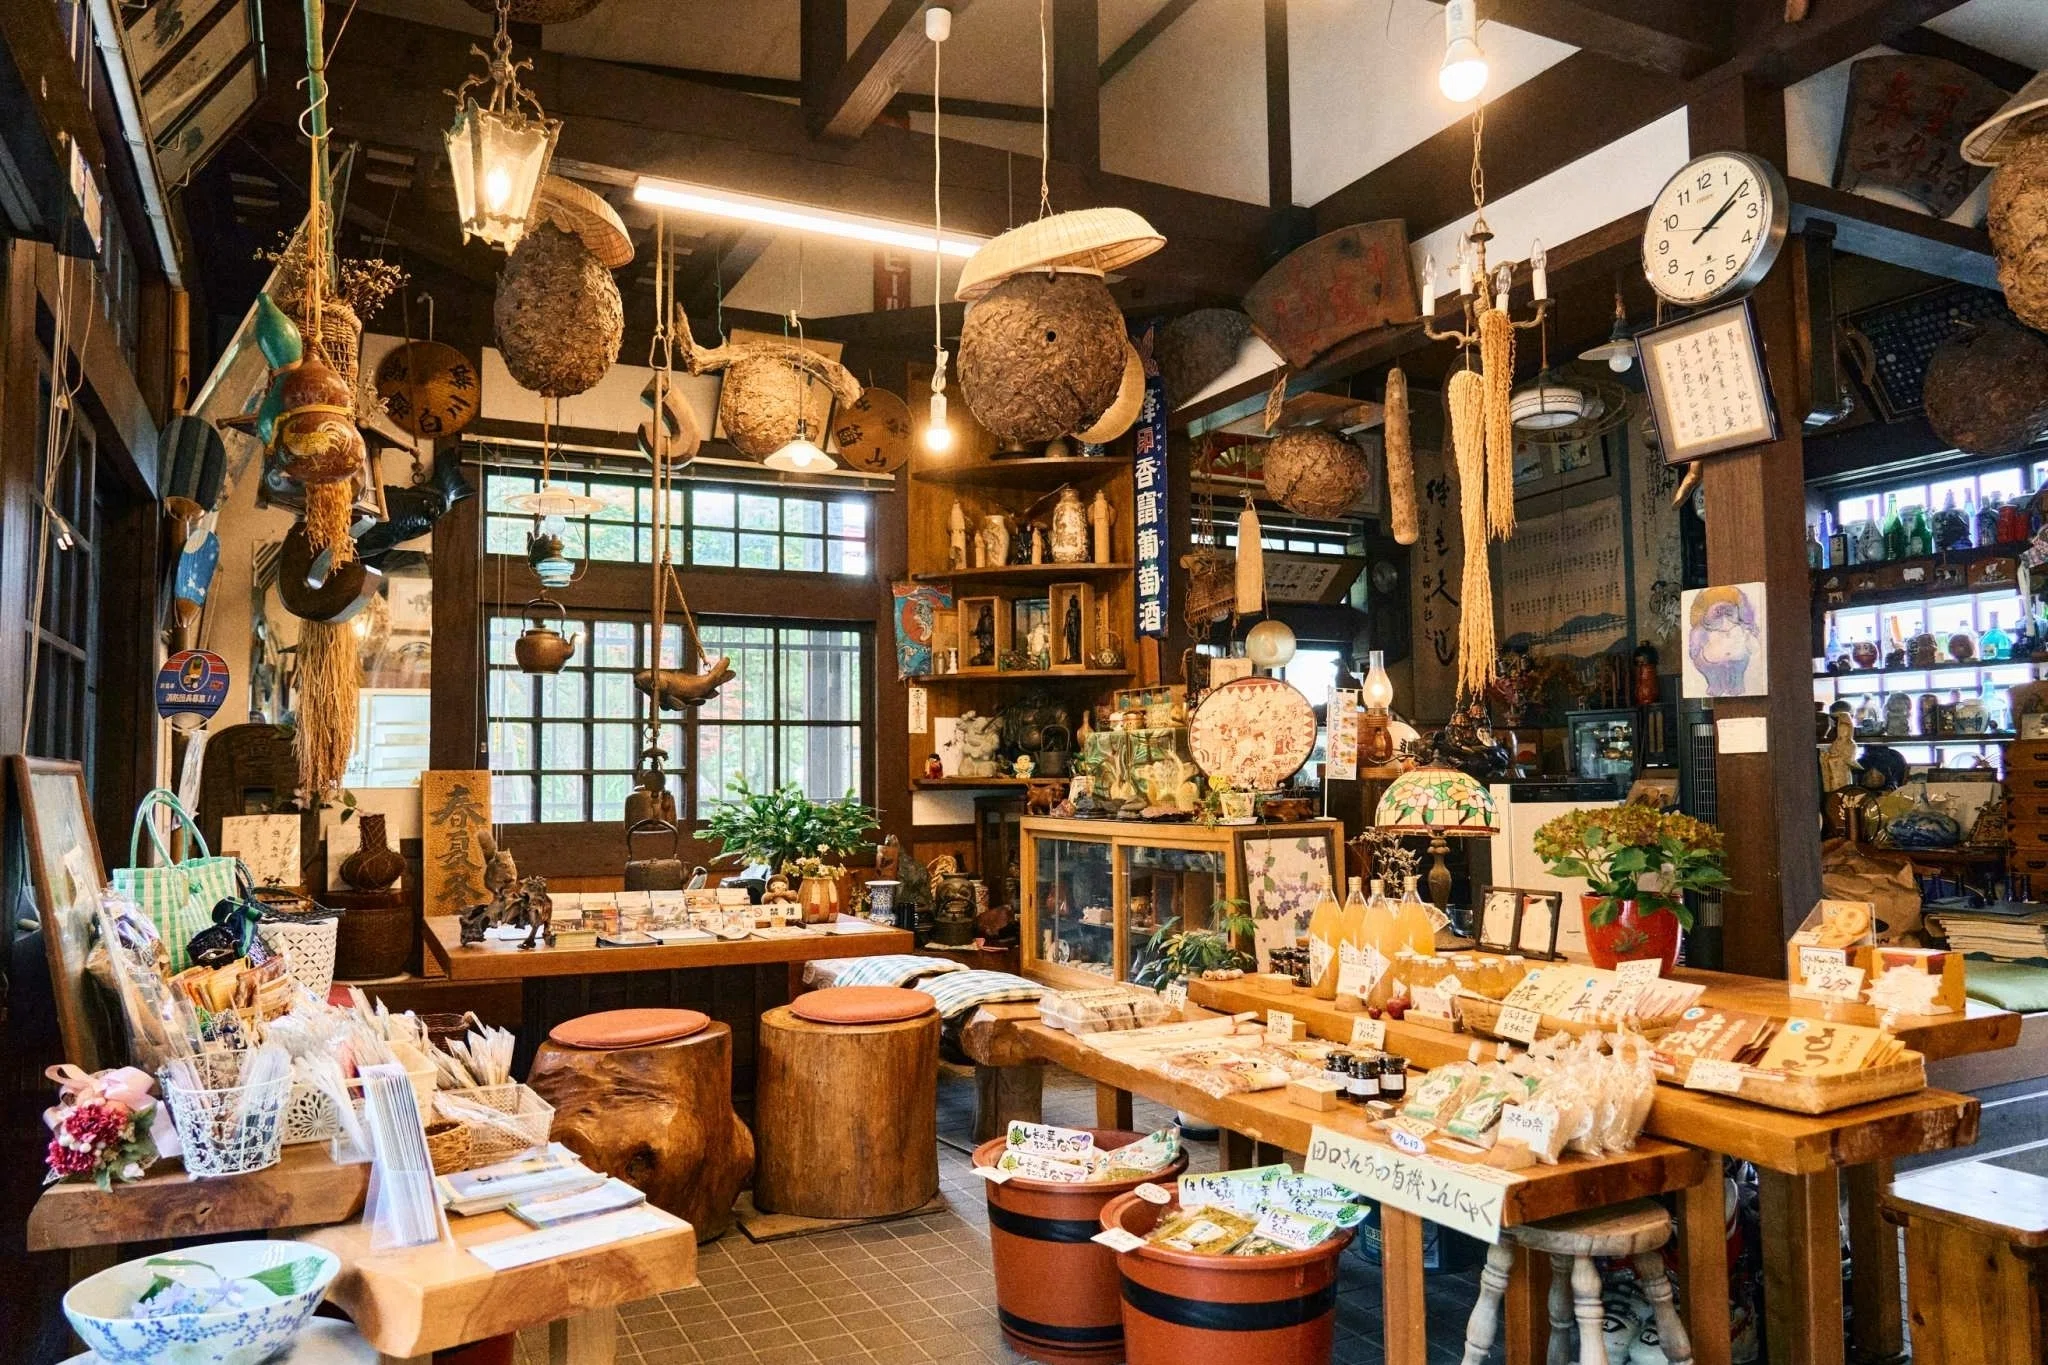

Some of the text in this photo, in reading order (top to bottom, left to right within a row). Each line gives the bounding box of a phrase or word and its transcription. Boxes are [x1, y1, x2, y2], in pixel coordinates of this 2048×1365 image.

[1696, 172, 1712, 191] 12
[1722, 171, 1729, 186] 1
[1677, 189, 1690, 206] 11
[1738, 181, 1751, 199] 2
[1746, 202, 1758, 219] 3
[1663, 214, 1679, 232] 10
[1741, 229, 1753, 244] 4
[1658, 240, 1670, 255] 9
[1668, 259, 1679, 275] 8
[1725, 254, 1737, 270] 5
[1684, 270, 1695, 286] 7
[1704, 269, 1715, 285] 6
